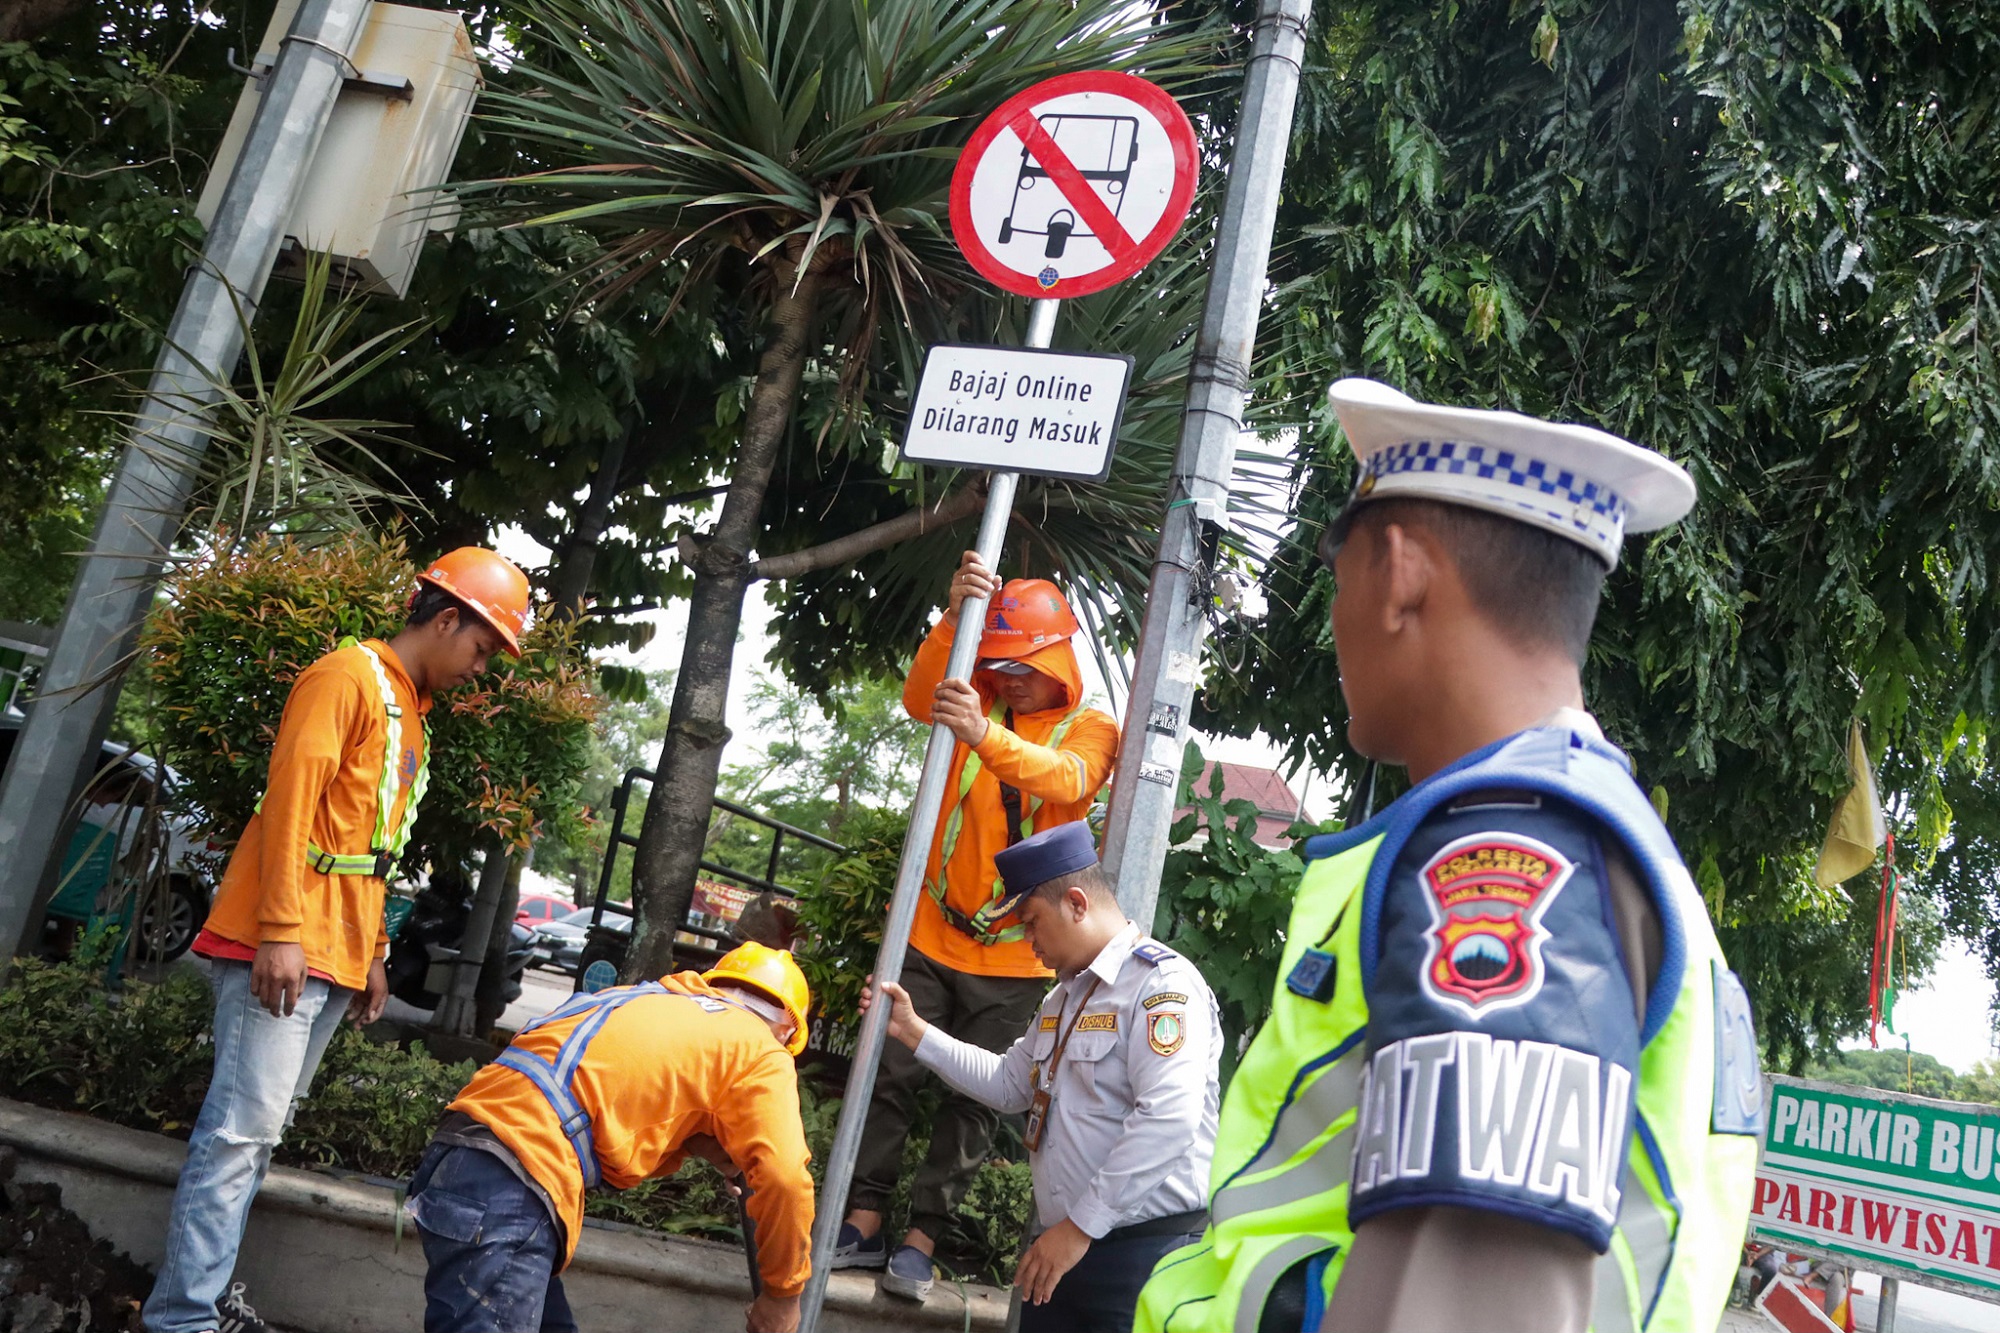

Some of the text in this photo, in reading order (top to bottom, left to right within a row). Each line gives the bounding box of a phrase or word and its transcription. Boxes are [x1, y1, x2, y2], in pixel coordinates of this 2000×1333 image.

[949, 370, 1093, 402] Bajaj Online
[922, 407, 1102, 445] Dilarang Masuk
[1081, 1015, 1114, 1028] DISHUB
[1773, 1095, 2000, 1183] PARKIR BU
[1750, 1177, 2000, 1271] PARIWISAT
